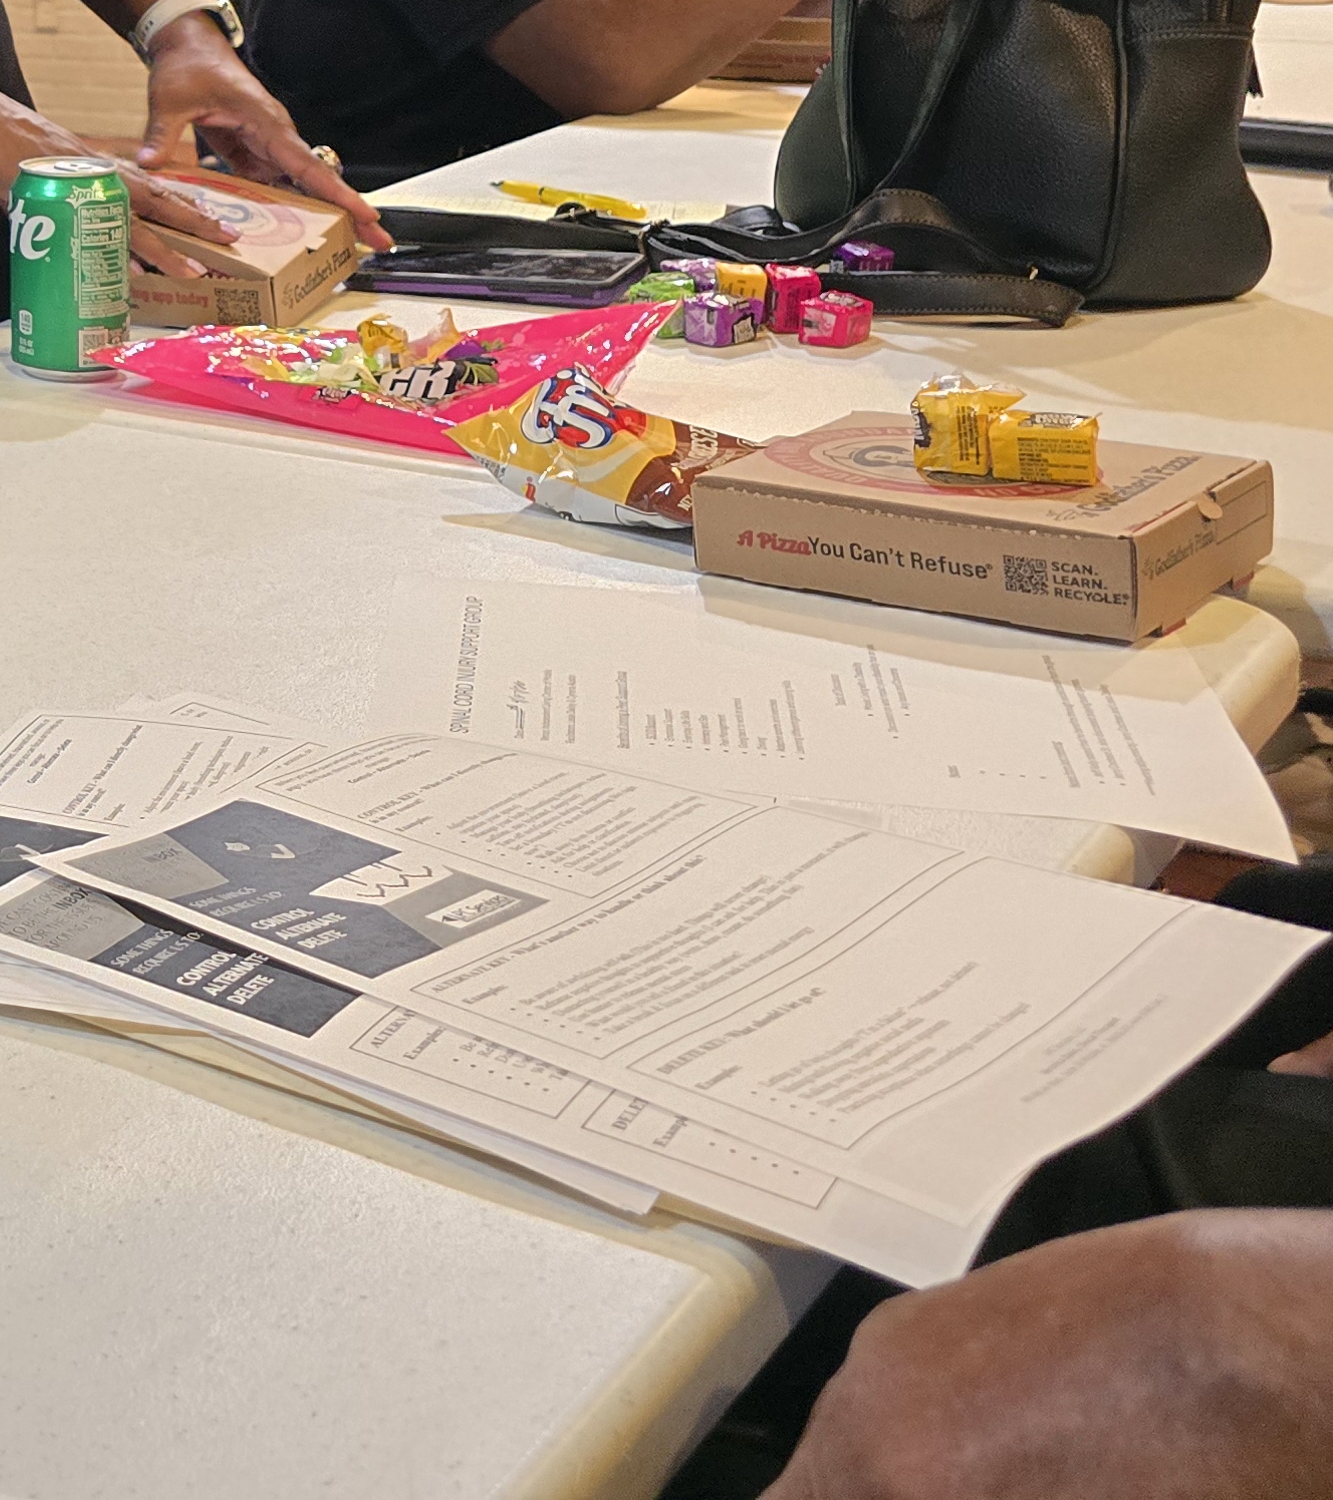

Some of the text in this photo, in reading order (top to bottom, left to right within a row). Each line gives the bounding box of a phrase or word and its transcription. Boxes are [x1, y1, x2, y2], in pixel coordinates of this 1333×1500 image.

[9, 199, 56, 261] te
[176, 290, 209, 308] today
[736, 529, 754, 547] A
[757, 530, 811, 555] Pizza
[807, 537, 844, 559] You
[849, 542, 905, 568] Can't
[1051, 560, 1099, 576] SCAN.
[1052, 574, 1109, 591] LEARN.
[449, 595, 483, 734] SPINAL CORD INJURY SUPPORT GROUP
[357, 800, 401, 819] CONTROL
[52, 887, 92, 911] INBOX
[250, 907, 315, 931] CONTROL
[275, 912, 348, 941] ALTERNATE
[296, 929, 348, 950] DELETE
[110, 949, 144, 967] SOME
[132, 947, 174, 975] REQUIRE
[176, 950, 237, 987] CONTROL
[202, 952, 270, 998] ALTERNATE
[432, 965, 490, 992] ALTERNATE
[226, 974, 275, 1006] DELETE
[370, 1009, 417, 1049] ALTERNA
[657, 1049, 705, 1074] DELETE
